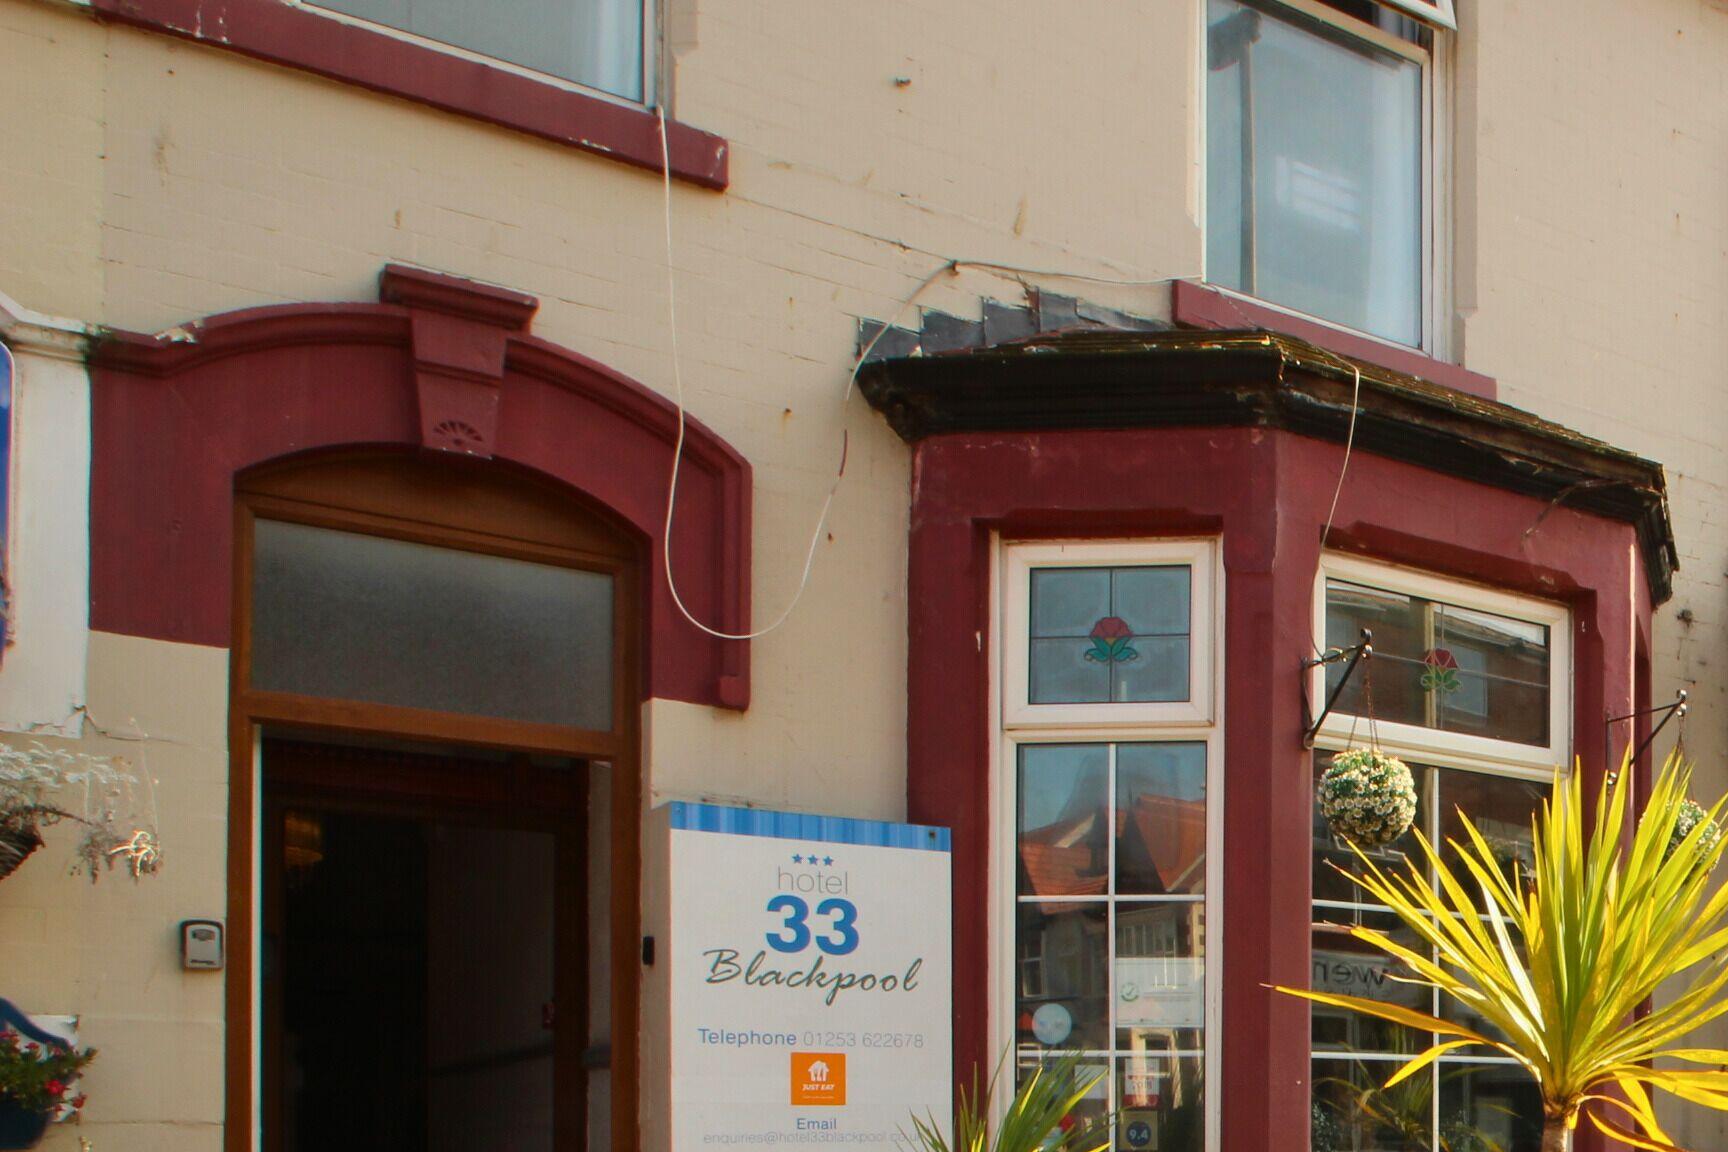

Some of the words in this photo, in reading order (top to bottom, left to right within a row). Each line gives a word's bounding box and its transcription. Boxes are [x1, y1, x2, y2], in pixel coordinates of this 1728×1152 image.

[777, 866, 849, 895] hotel
[765, 894, 860, 955] 33
[702, 949, 923, 1006] Blackpool
[697, 1028, 797, 1047] Telephone
[803, 1031, 856, 1048] 01253
[862, 1031, 924, 1049] 622678
[802, 1083, 819, 1092] JUST
[820, 1083, 835, 1092] EAT
[796, 1117, 837, 1131] Email
[1129, 1128, 1149, 1141] 9.4
